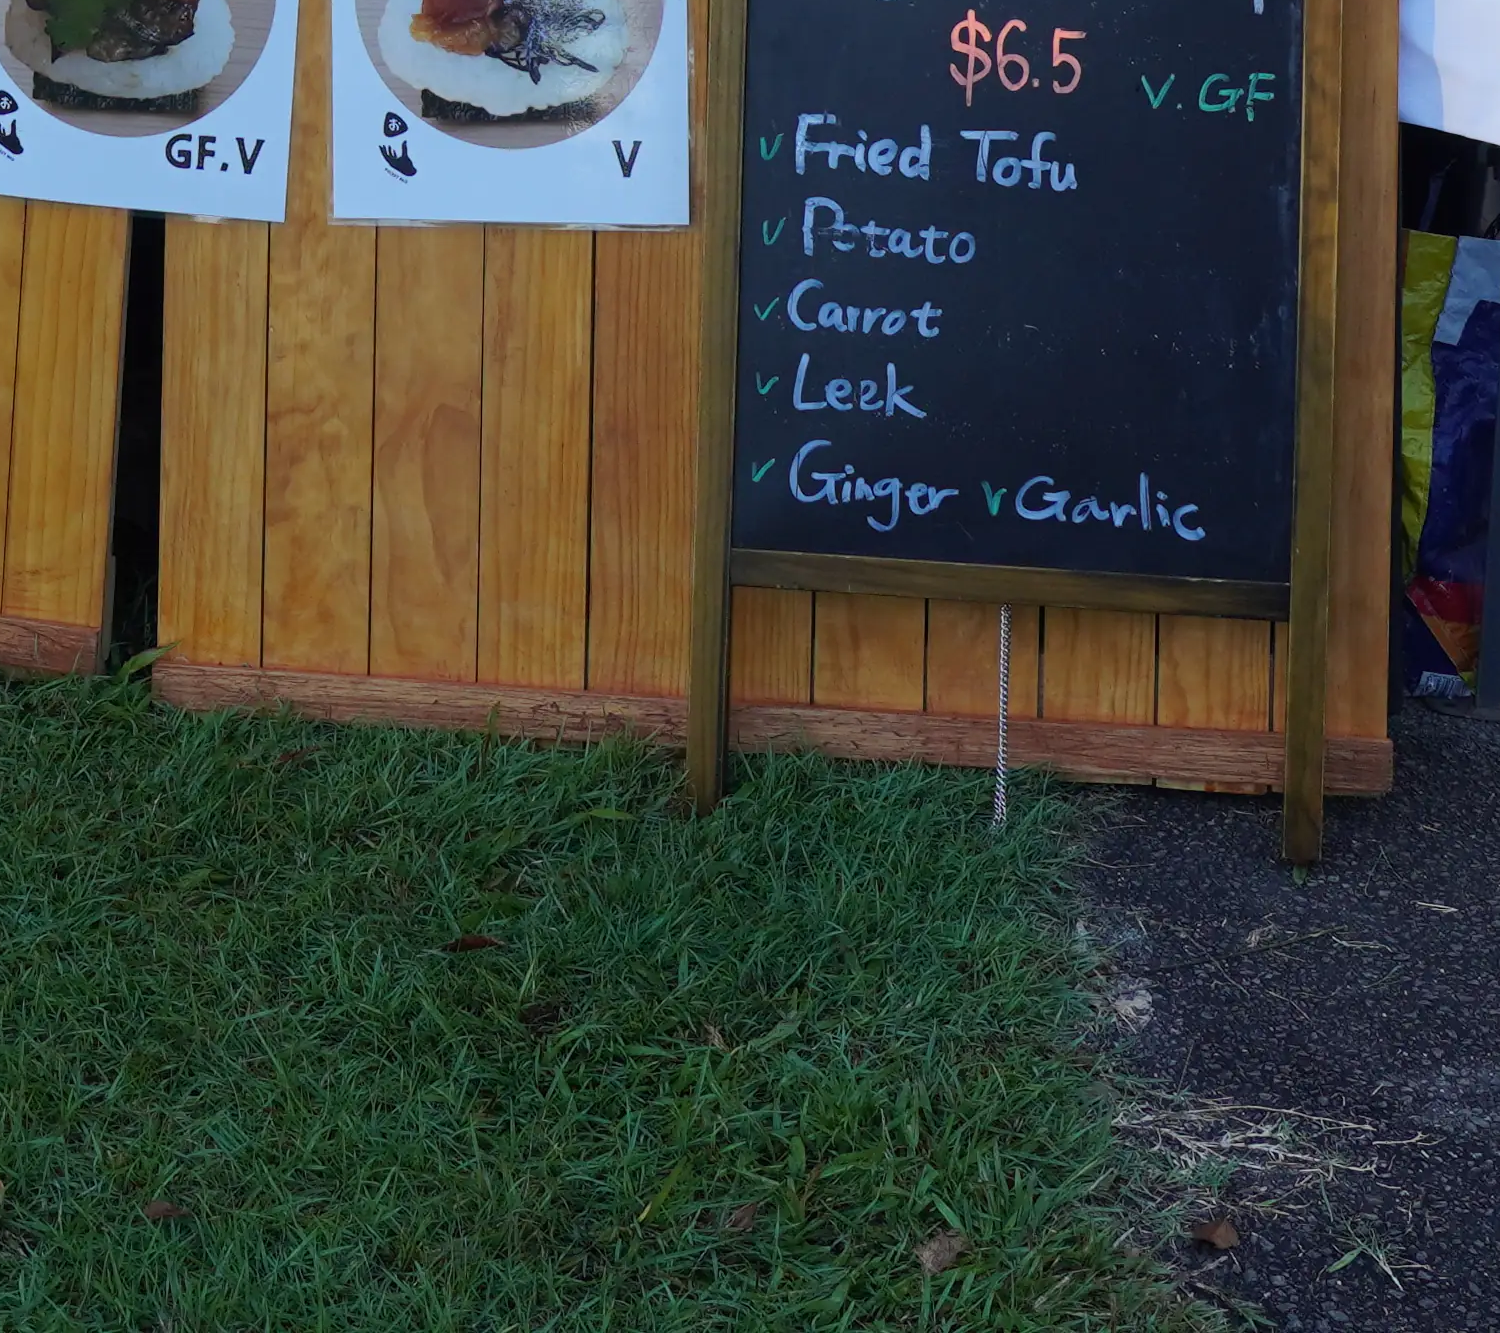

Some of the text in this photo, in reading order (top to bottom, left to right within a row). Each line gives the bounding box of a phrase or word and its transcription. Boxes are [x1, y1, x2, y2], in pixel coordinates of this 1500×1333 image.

[948, 8, 1088, 107] $6.5
[611, 140, 642, 178] V
[794, 112, 1078, 193] Fried Tofu
[802, 196, 976, 265] Potato
[786, 278, 943, 339] Carrot
[792, 352, 928, 419] Leek
[788, 438, 1207, 542] Ginger Garlic
